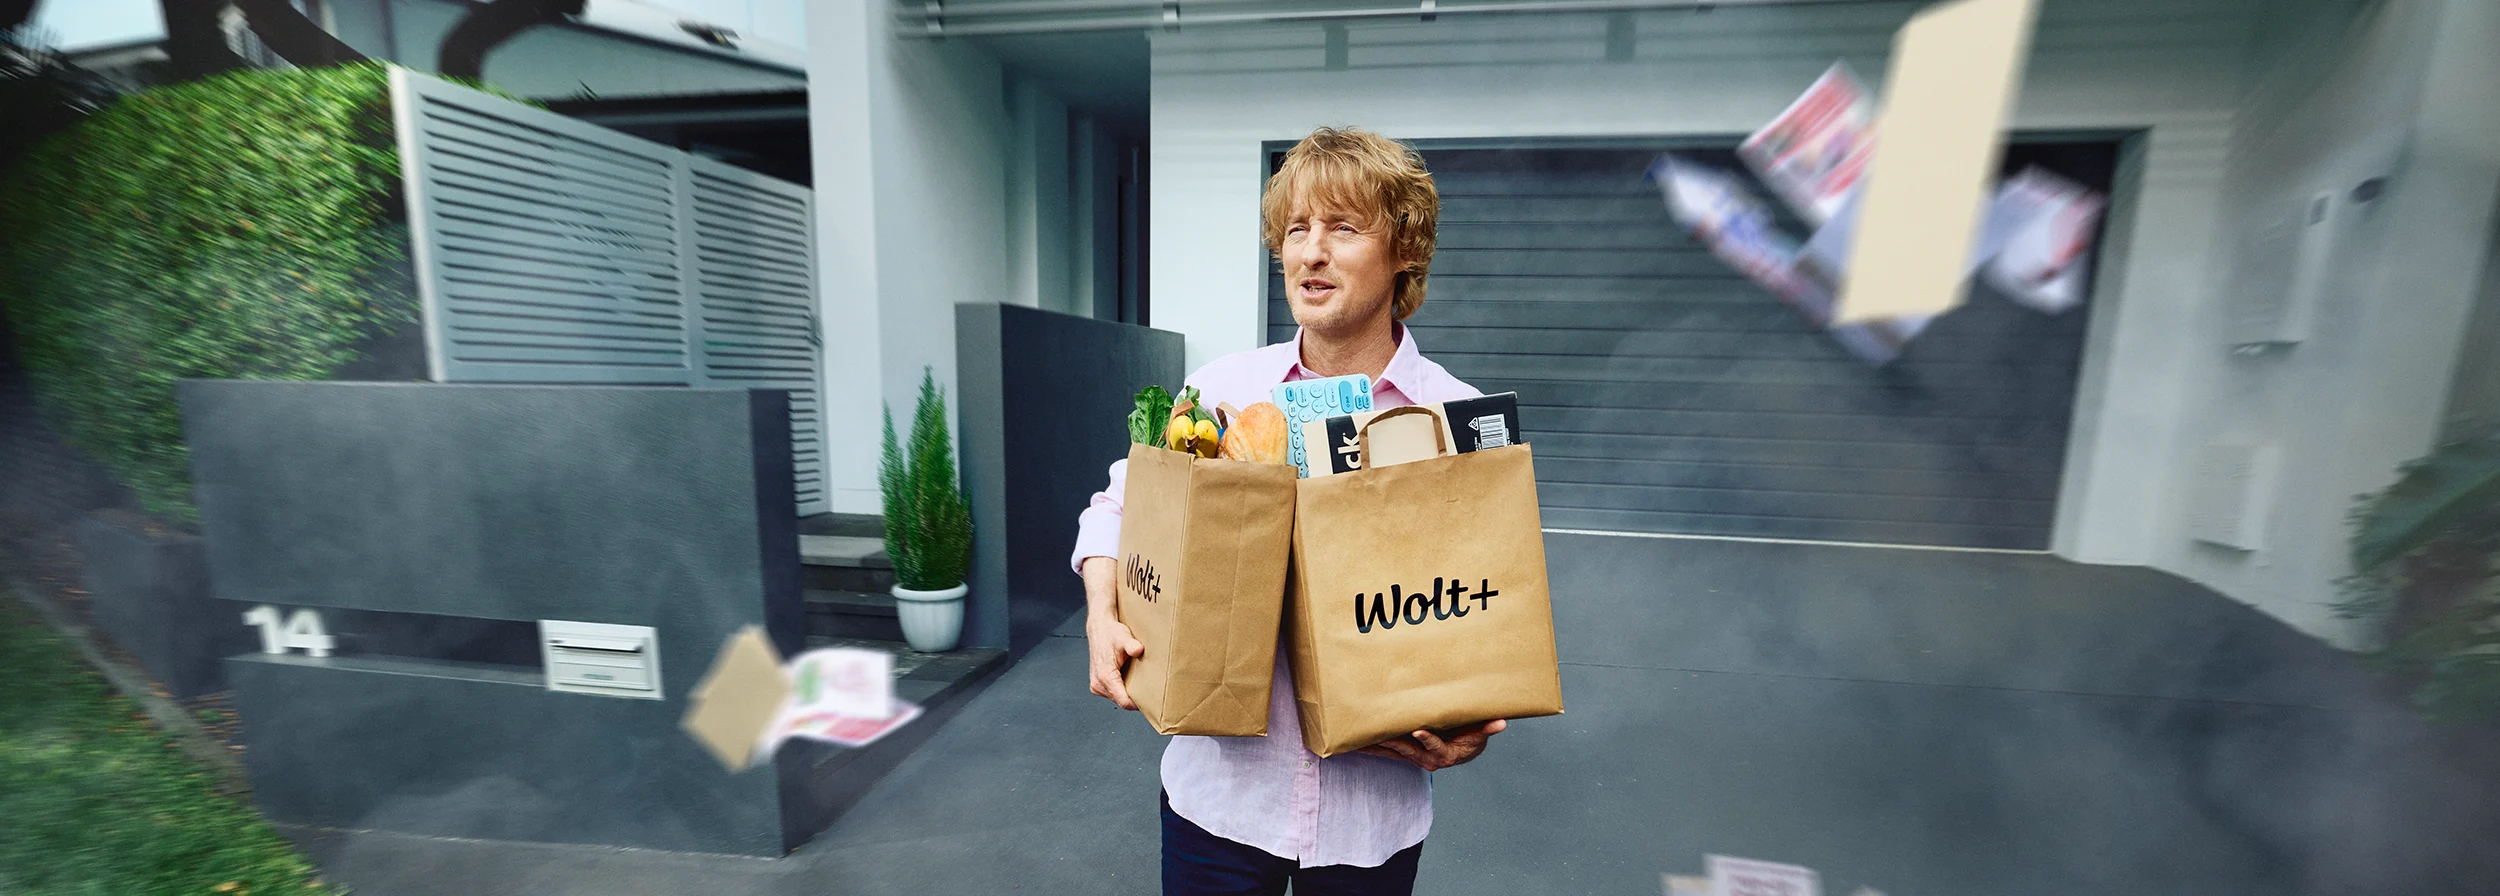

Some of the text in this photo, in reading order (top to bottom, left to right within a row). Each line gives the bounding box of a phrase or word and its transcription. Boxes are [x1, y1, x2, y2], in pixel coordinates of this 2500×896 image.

[1126, 553, 1161, 603] Wolt+
[242, 604, 337, 657] 14
[1355, 577, 1499, 634] Wolt+
